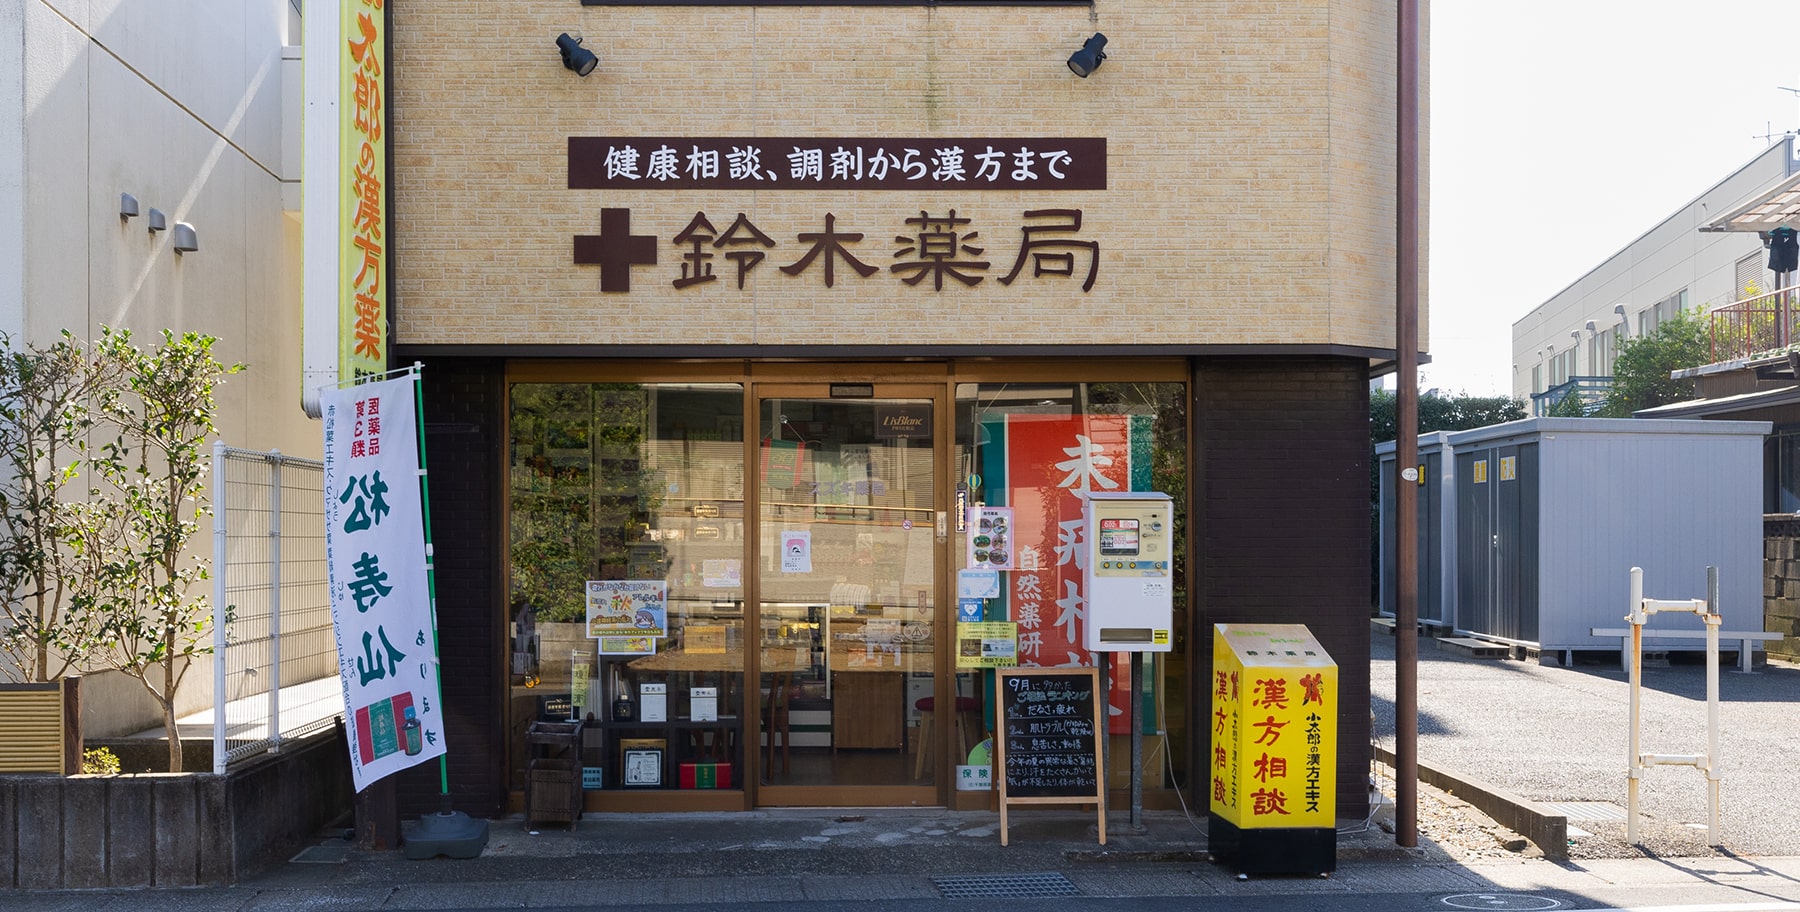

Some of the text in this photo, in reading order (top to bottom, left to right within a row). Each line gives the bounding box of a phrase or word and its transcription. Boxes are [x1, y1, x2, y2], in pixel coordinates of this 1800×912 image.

[603, 145, 1072, 181] 健康相談、調剤から漢方まで
[673, 209, 1100, 292] 鈴木薬局
[883, 416, 923, 426] LisBlanc
[808, 480, 886, 497] スズキ薬局
[1213, 670, 1228, 806] 漢方相談
[1250, 678, 1291, 815] 漢方相談
[1304, 712, 1321, 813] 小太郎の漢方エキス
